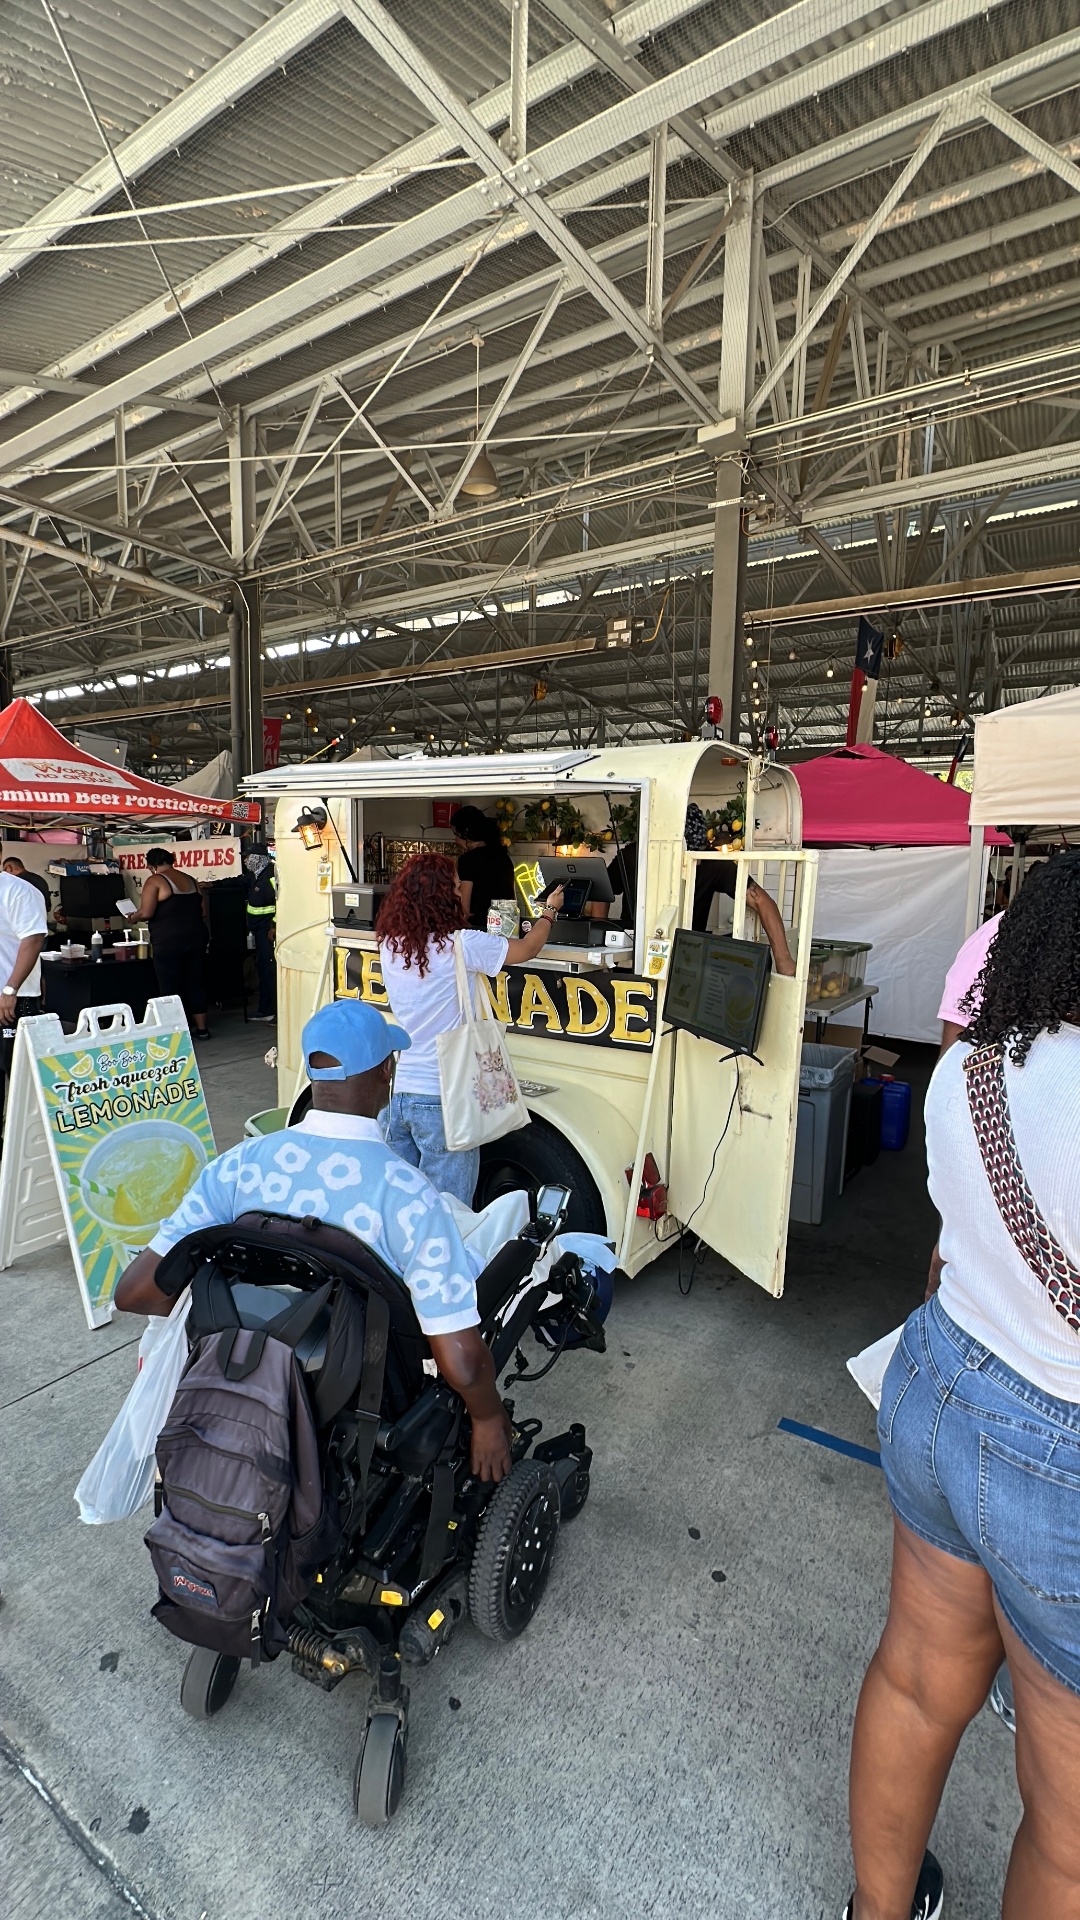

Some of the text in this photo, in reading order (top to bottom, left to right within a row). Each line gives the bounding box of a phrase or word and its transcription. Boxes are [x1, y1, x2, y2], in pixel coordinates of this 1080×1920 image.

[0, 788, 71, 803] mium
[125, 794, 224, 815] Potstickers
[119, 847, 235, 870] FRE AMPLES
[487, 916, 501, 926] IPS
[334, 947, 654, 1046] LENADE
[55, 1057, 187, 1102] fresh squeezed
[55, 1078, 199, 1133] LEMONADE
